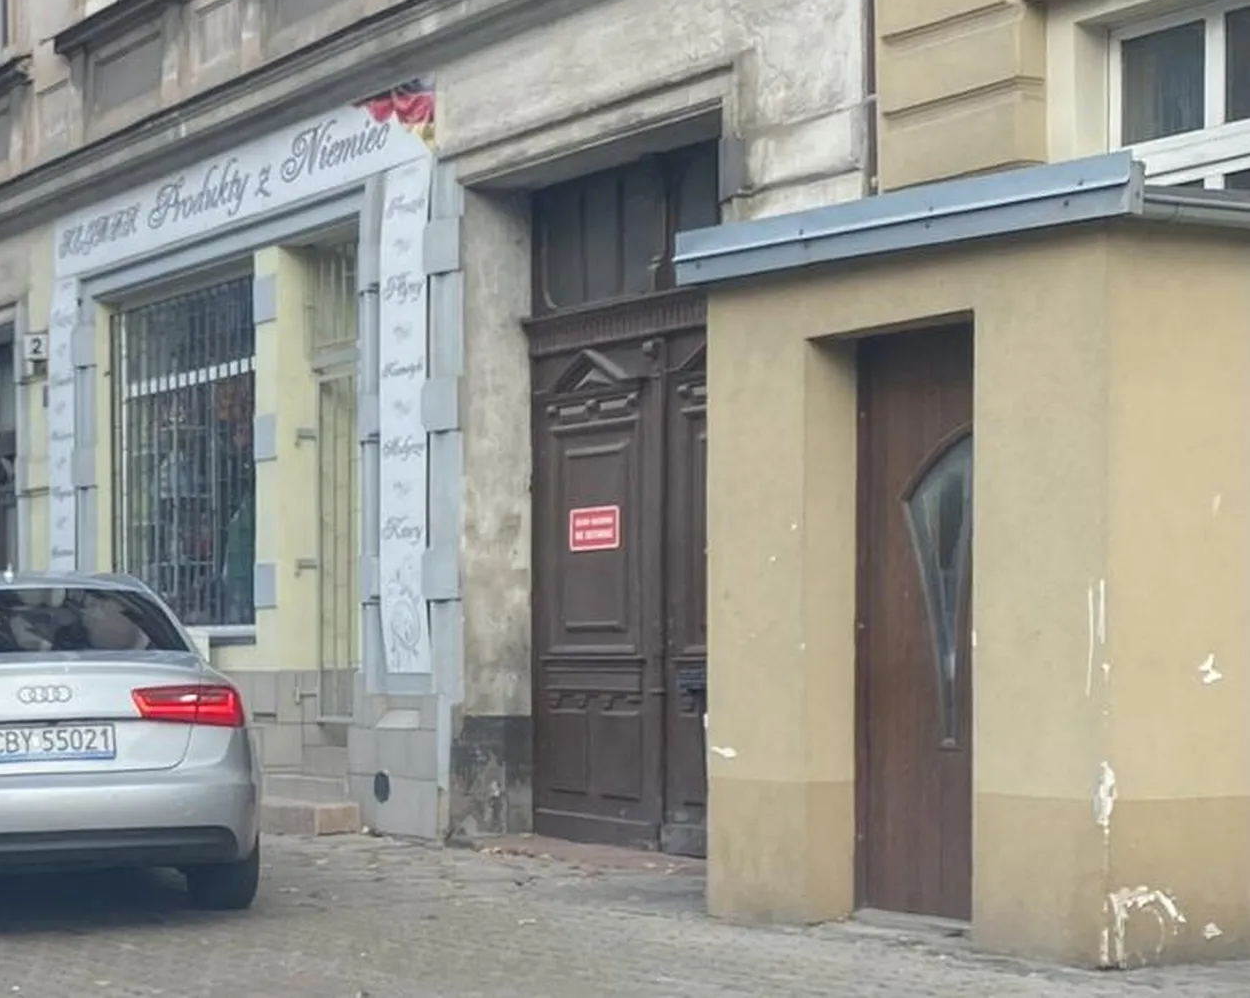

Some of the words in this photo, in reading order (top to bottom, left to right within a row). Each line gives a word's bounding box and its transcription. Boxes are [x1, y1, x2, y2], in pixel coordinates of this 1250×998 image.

[147, 158, 249, 230] Produkty
[254, 162, 273, 198] z
[280, 119, 391, 184] Niemiec
[32, 337, 42, 355] 2
[41, 728, 110, 752] 55021
